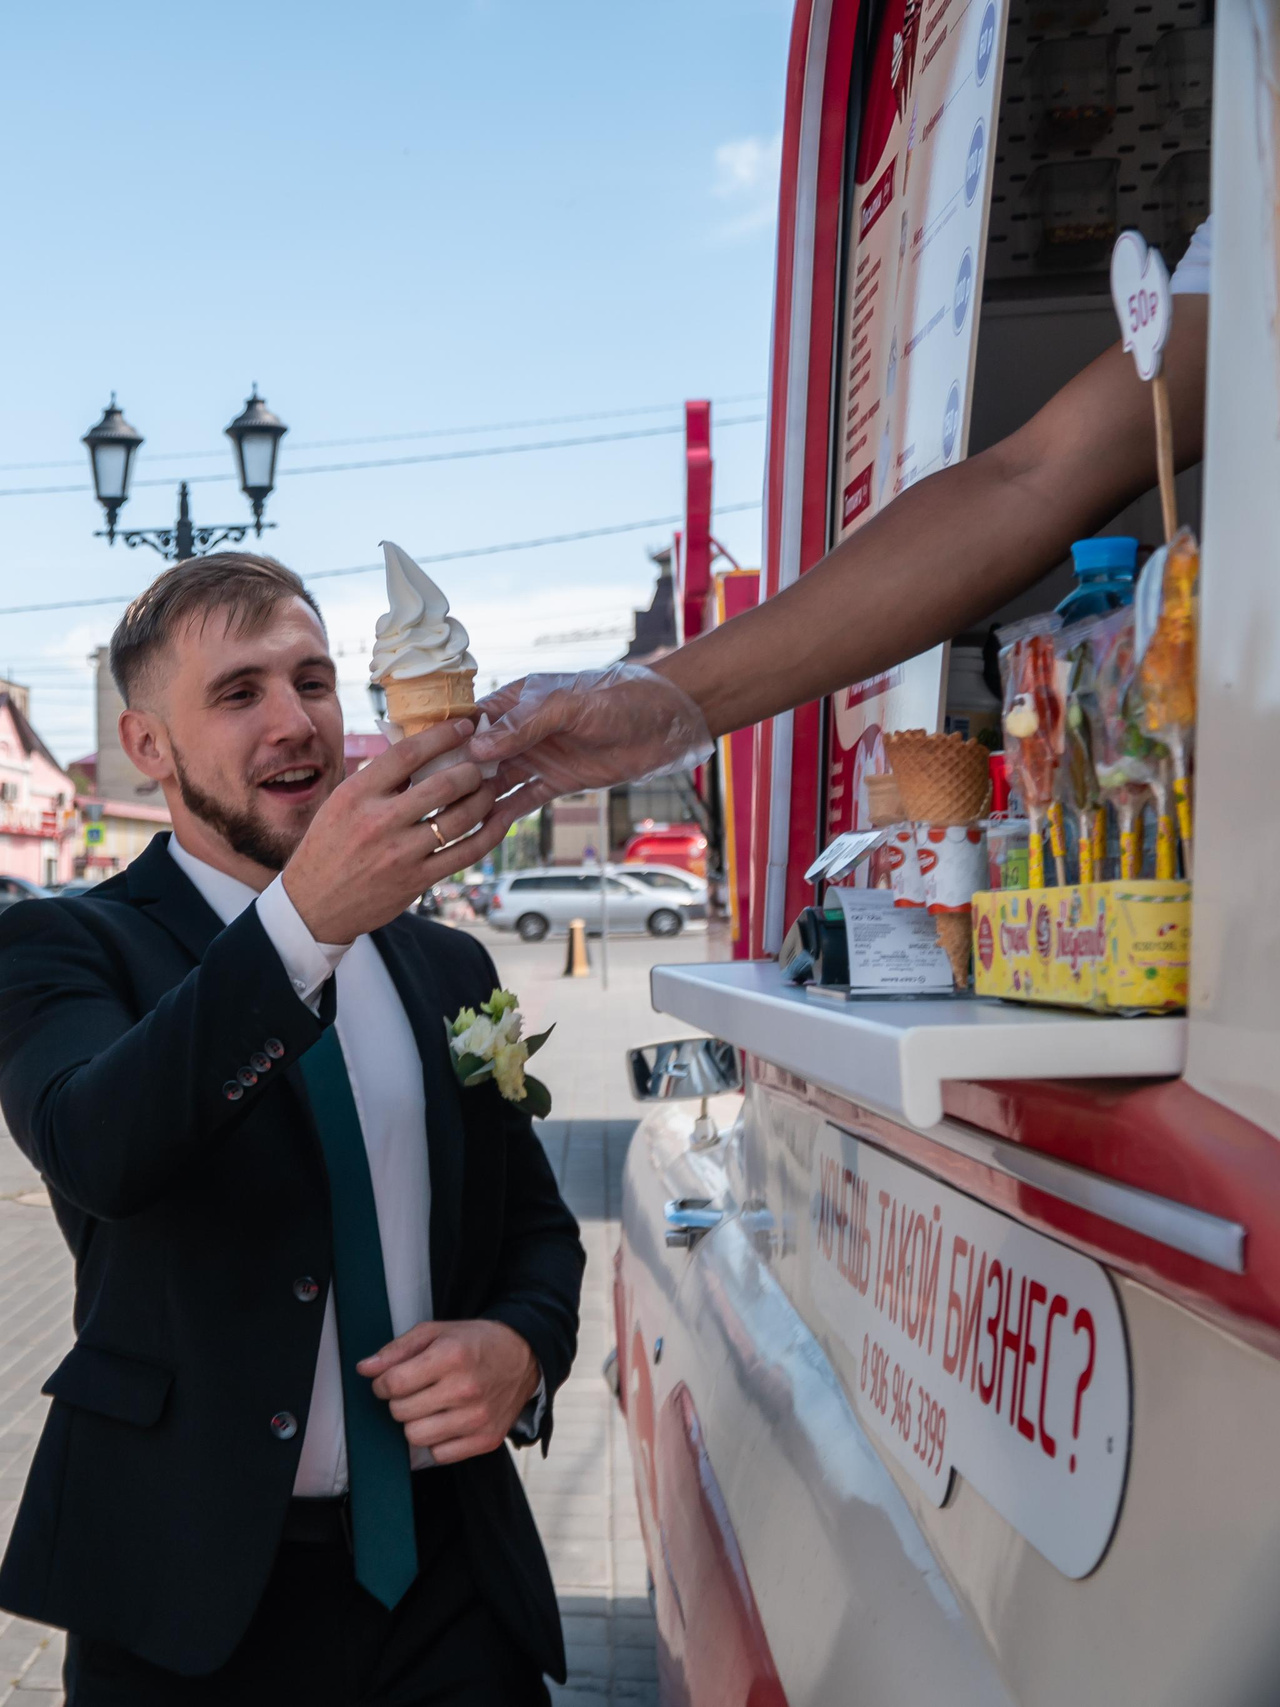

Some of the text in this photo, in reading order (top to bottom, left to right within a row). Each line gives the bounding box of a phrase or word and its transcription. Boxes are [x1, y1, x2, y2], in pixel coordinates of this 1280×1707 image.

[817, 1152, 1097, 1474] ХОЧЕШЬ ТАКОЙ БИЗНЕС?
[860, 1332, 947, 1477] 8 906 946 3399
